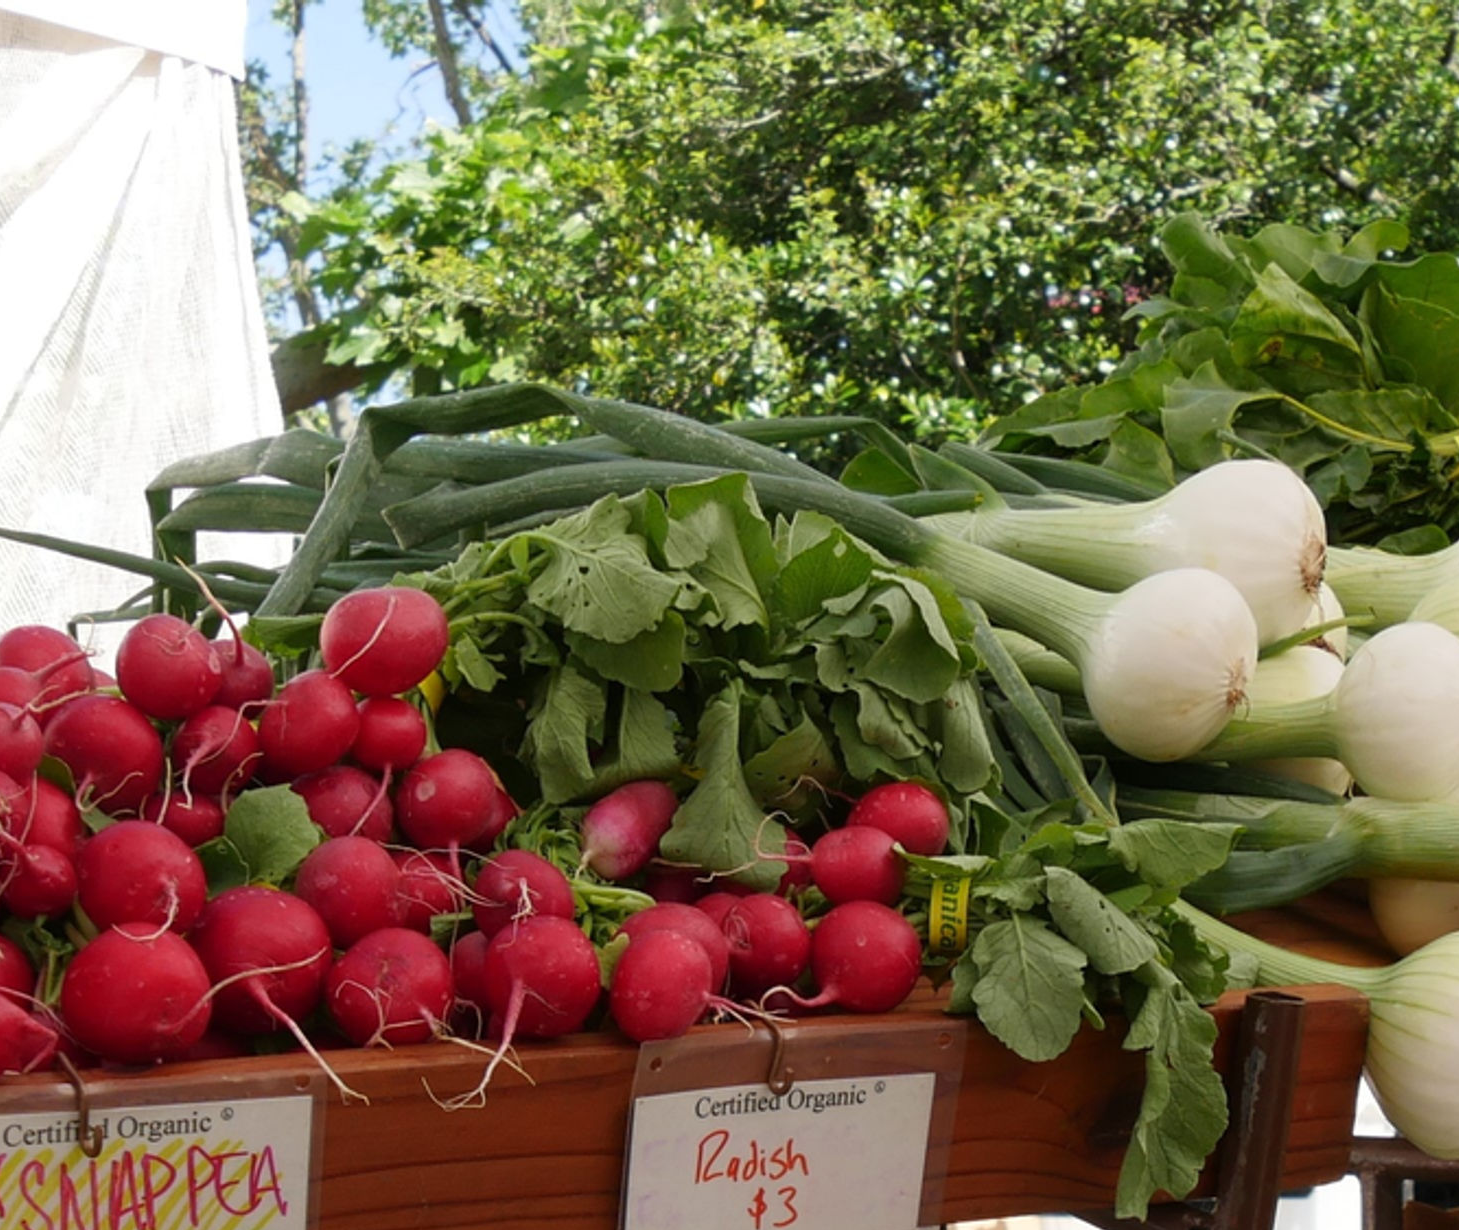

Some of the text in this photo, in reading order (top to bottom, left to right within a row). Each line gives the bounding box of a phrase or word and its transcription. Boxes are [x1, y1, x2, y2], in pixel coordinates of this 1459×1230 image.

[695, 1085, 867, 1119] Certified Organic
[3, 1111, 212, 1147] Certifid Organic
[695, 1129, 809, 1185] Radish
[747, 1186, 799, 1230] $3
